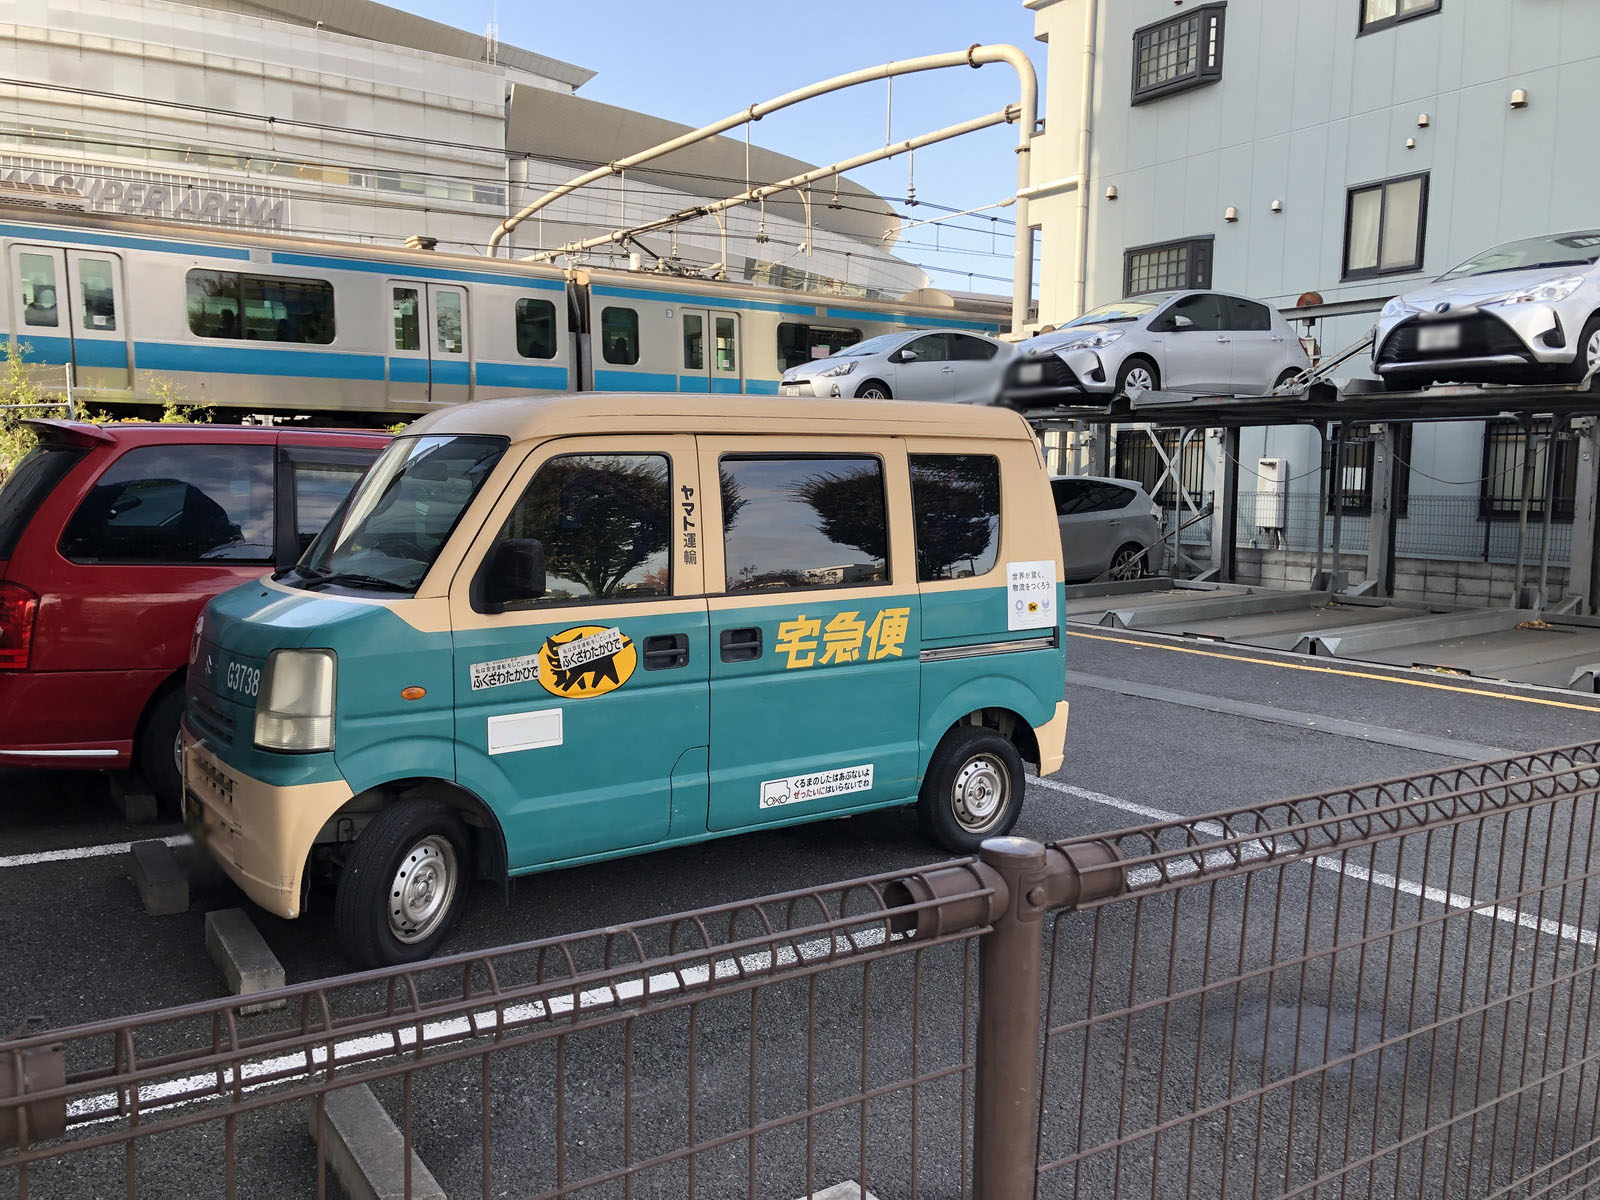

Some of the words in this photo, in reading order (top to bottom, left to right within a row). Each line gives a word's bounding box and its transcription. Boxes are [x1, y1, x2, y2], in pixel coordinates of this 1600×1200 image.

[172, 189, 284, 229] ARENA
[680, 485, 697, 565] ヤマト運輸
[562, 638, 621, 668] ふくざわたかひで
[775, 607, 911, 669] 宅急便
[227, 661, 261, 697] G3738
[473, 666, 539, 689] ふくざわたかひで
[793, 779, 870, 799] ぜったいにはいらないでね
[794, 768, 870, 789] くるまのしたはあぶないよ
